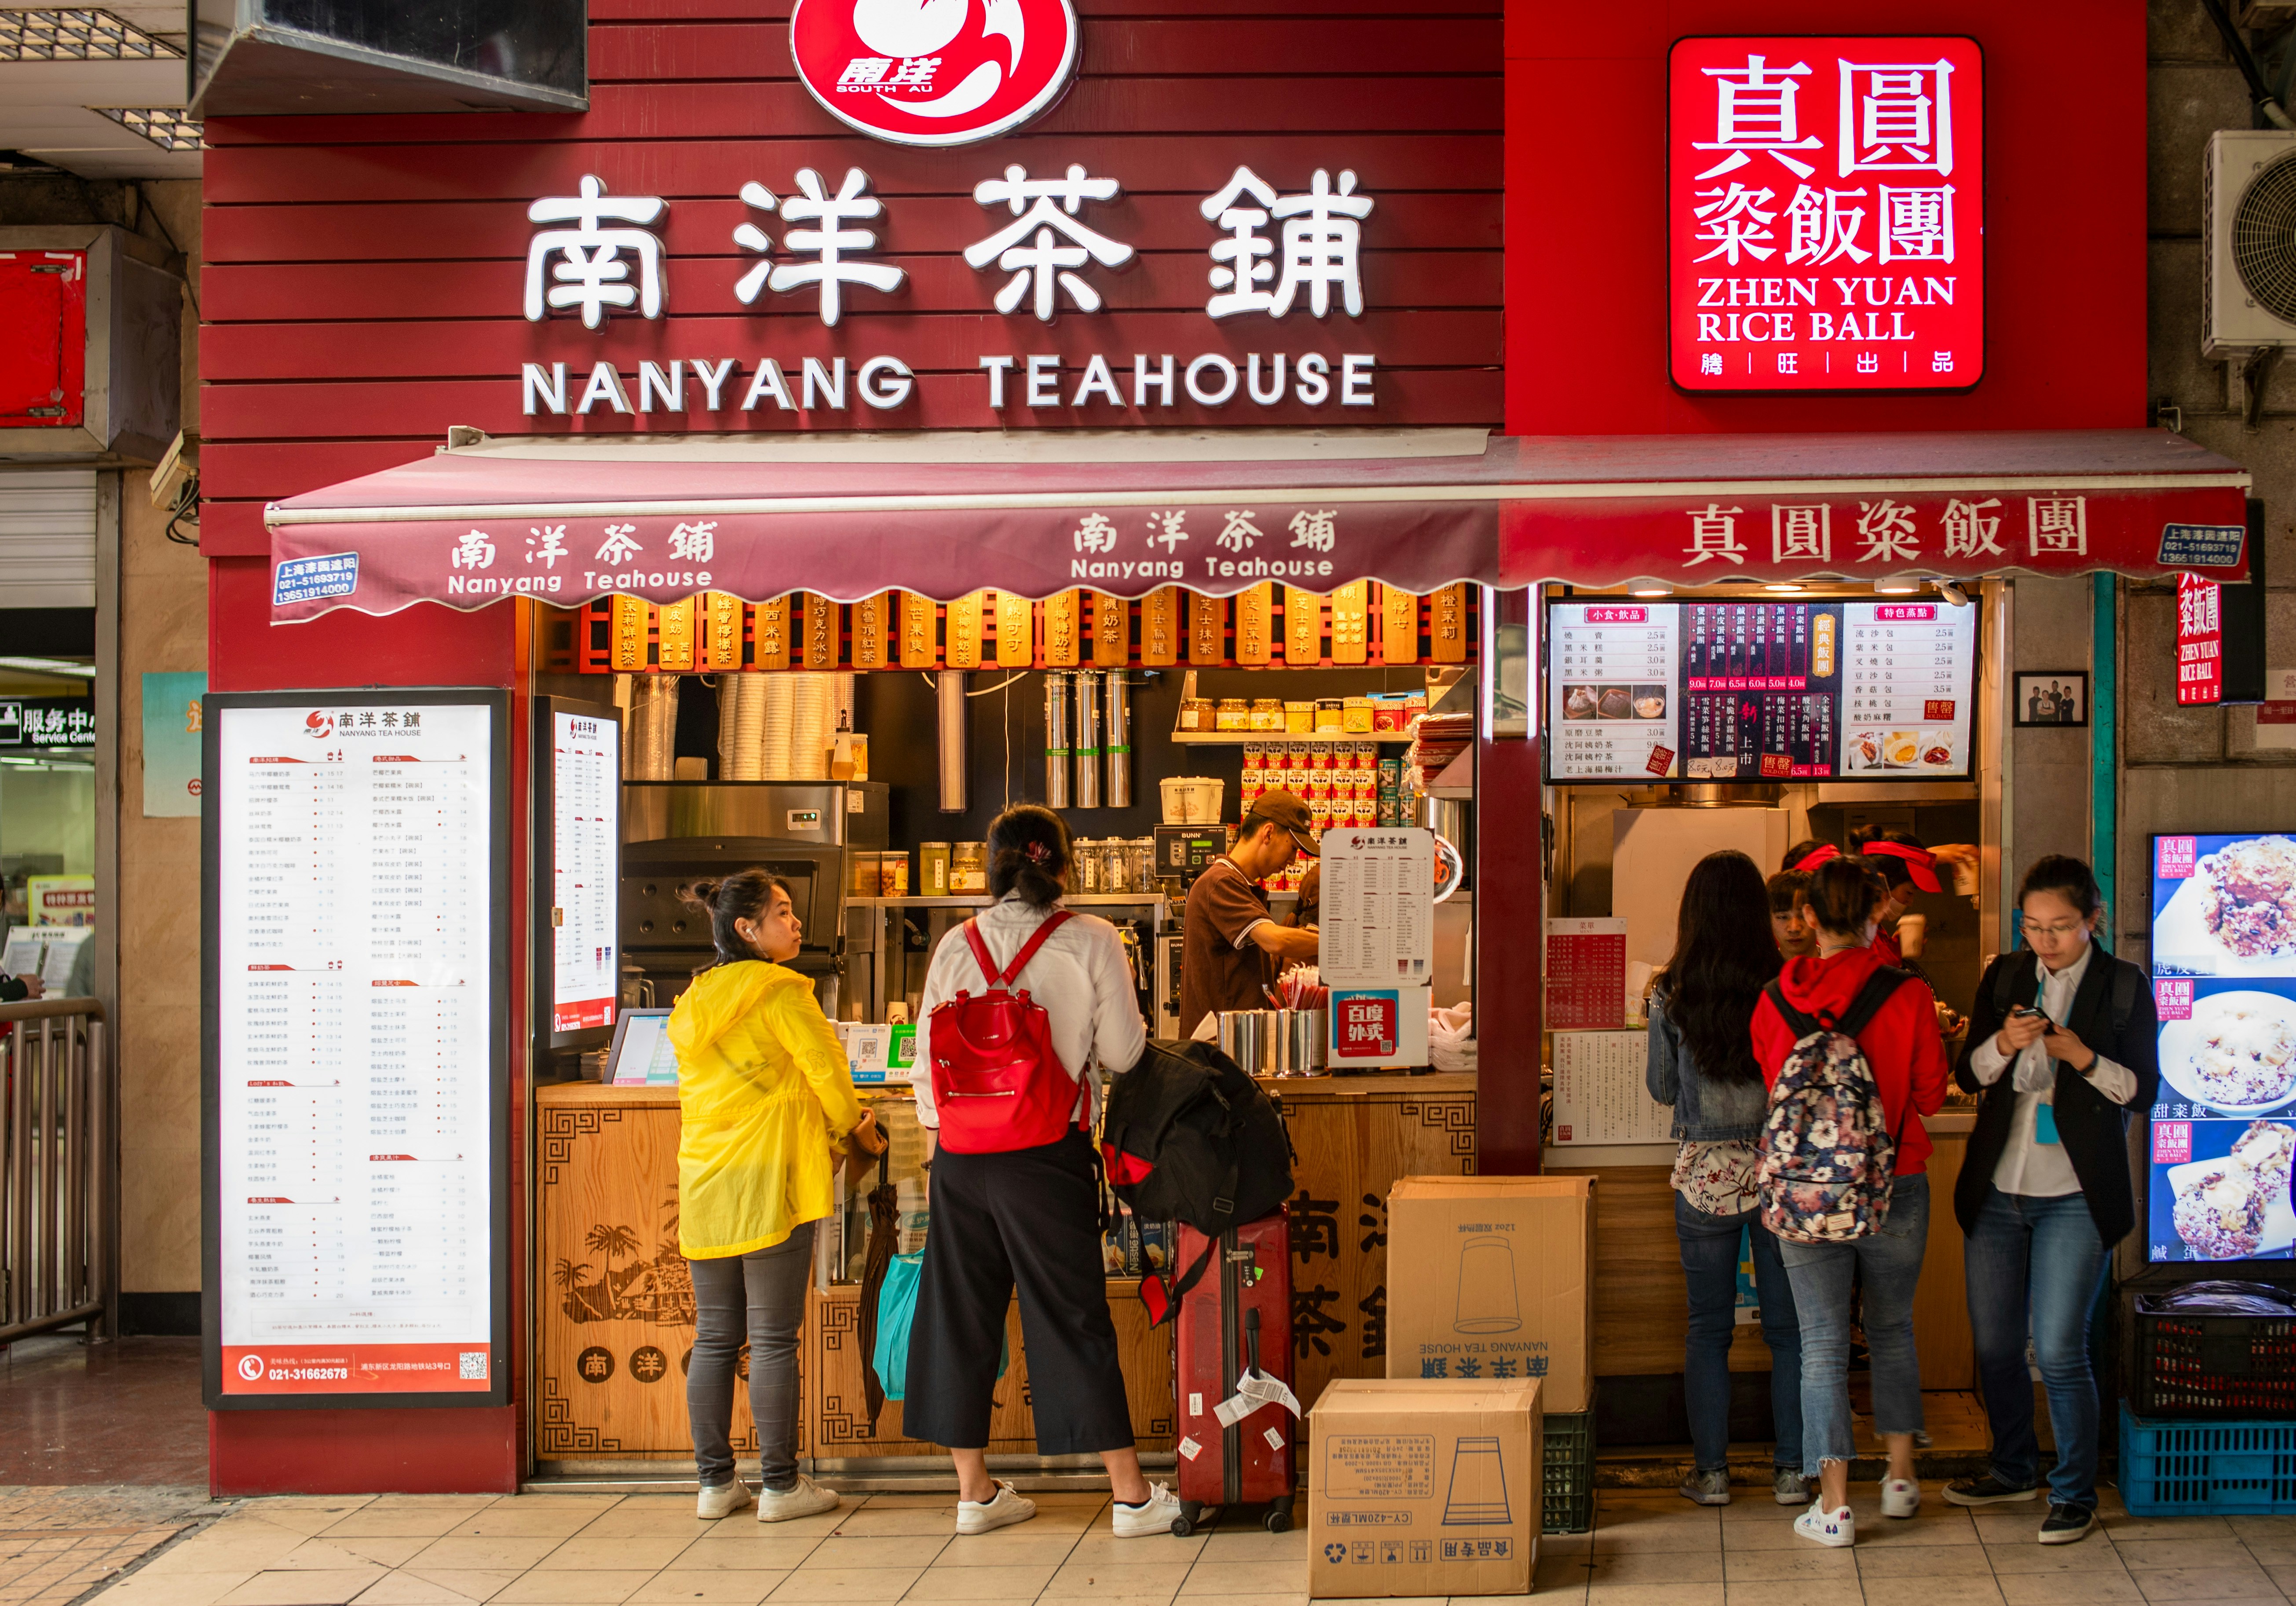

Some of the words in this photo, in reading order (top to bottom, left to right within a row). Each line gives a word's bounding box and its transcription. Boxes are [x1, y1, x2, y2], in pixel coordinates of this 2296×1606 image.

[838, 58, 942, 83] 南洋
[1692, 55, 1955, 180] 真圓
[1693, 182, 1956, 266] 粢飯團
[523, 165, 1374, 328] 南洋茶鋪
[1698, 278, 1819, 307] ZHEN
[1833, 277, 1956, 306] YUAN
[1697, 312, 1795, 341] RICE
[1809, 312, 1915, 340] BALL
[522, 356, 915, 415] NANYANG
[980, 353, 1377, 407] TEAHOUSE
[1073, 509, 1337, 554] 南洋茶鋪
[1682, 496, 2088, 568] 真圓粢飯團
[452, 520, 717, 570] 南洋茶鋪
[2165, 542, 2237, 552] 021-51693719
[1071, 559, 1183, 579] Nanyang
[1206, 557, 1333, 577] Teahouse
[2163, 554, 2233, 563] 13651914000
[278, 572, 353, 591] 021-51693719
[449, 573, 561, 595] Nanyang
[585, 570, 712, 590] Teahouse
[277, 583, 350, 602] 13651914000
[717, 592, 732, 664] 蜂蜜檸檬茶
[1199, 594, 1213, 655] 芝士抹茶
[1716, 606, 1725, 654] 虎皮蛋飯團
[679, 642, 690, 662] 芒果
[1817, 620, 1831, 672] 經典飯團
[2181, 643, 2199, 661] ZHEN
[2200, 640, 2218, 658] YUAN
[2181, 664, 2196, 682] RICE
[2197, 662, 2212, 680] BALL
[23, 708, 95, 734] 服务中
[340, 712, 420, 728] 南洋茶鋪
[32, 731, 68, 744] Service
[2162, 839, 2192, 854] 真圓
[2160, 982, 2190, 996] 真圓
[1348, 1004, 1383, 1022] 百度
[1349, 1024, 1384, 1042] 外卖
[2158, 1124, 2188, 1138] 真圓
[1420, 1344, 1460, 1354] HOUSE
[1465, 1343, 1487, 1352] TEA
[1491, 1342, 1547, 1352] NANYANG
[269, 1369, 347, 1380] 021-31662678
[1420, 1355, 1548, 1379] 南洋茶鋪
[1445, 1540, 1508, 1557] 食品专用
